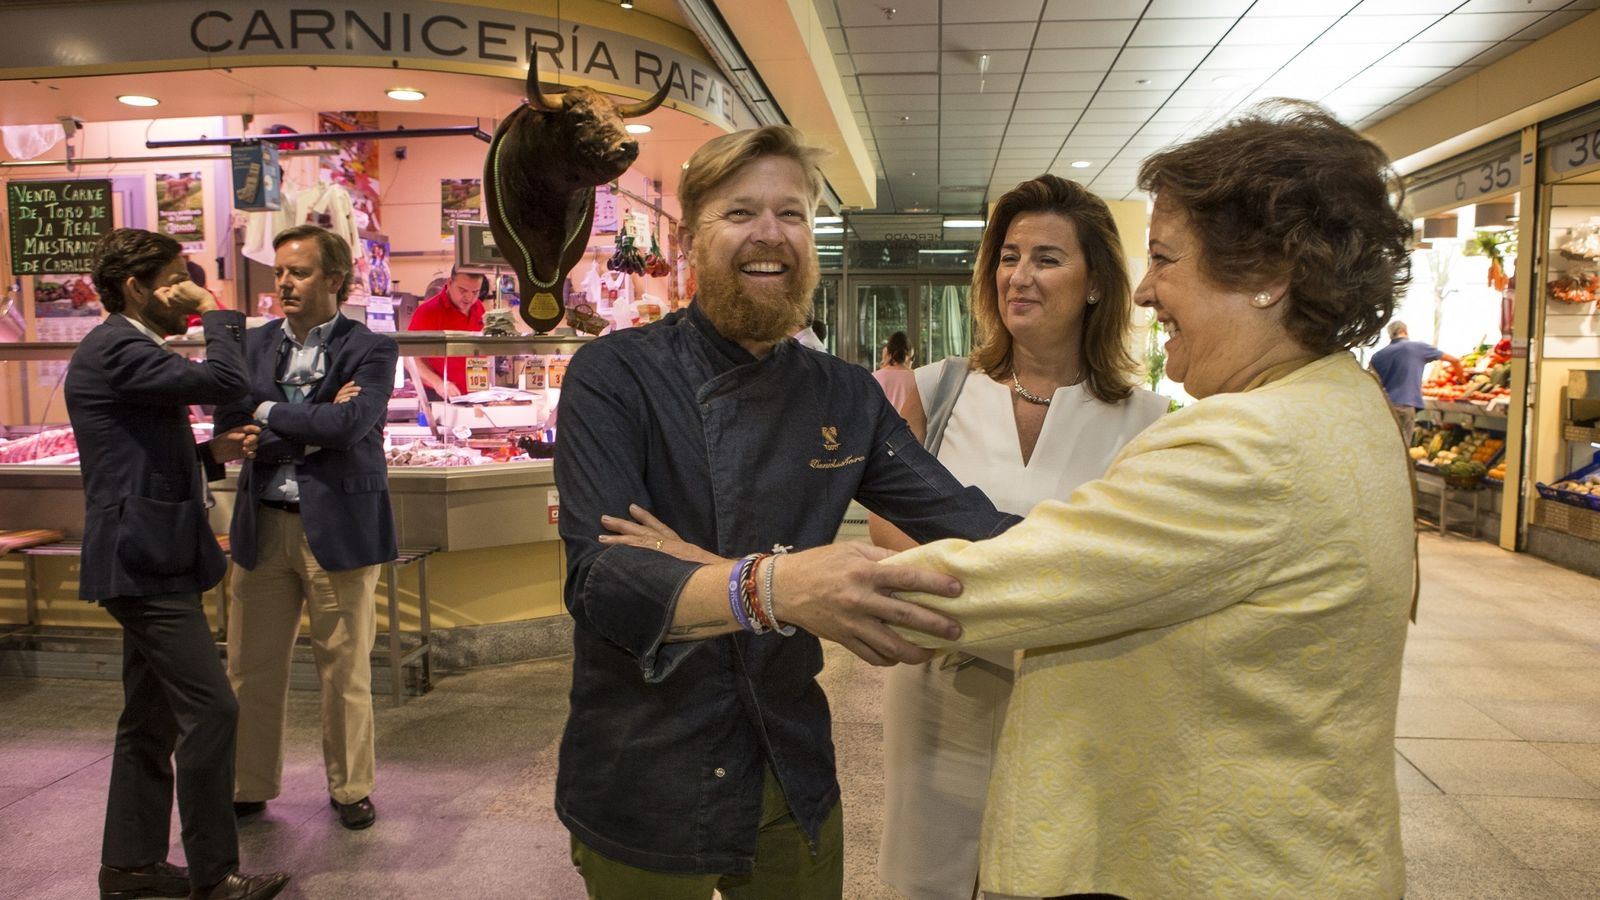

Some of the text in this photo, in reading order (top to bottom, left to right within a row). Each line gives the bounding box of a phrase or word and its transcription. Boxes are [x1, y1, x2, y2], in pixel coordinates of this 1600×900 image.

[191, 8, 738, 128] CARNICERÍA RAFAEL
[1479, 160, 1512, 194] 35
[14, 184, 104, 203] VENTA CARNE
[18, 201, 106, 220] DE TORO DE
[34, 217, 101, 237] LA REAL
[23, 237, 97, 257] MAESTRANZ
[21, 257, 93, 273] DE CABALLE
